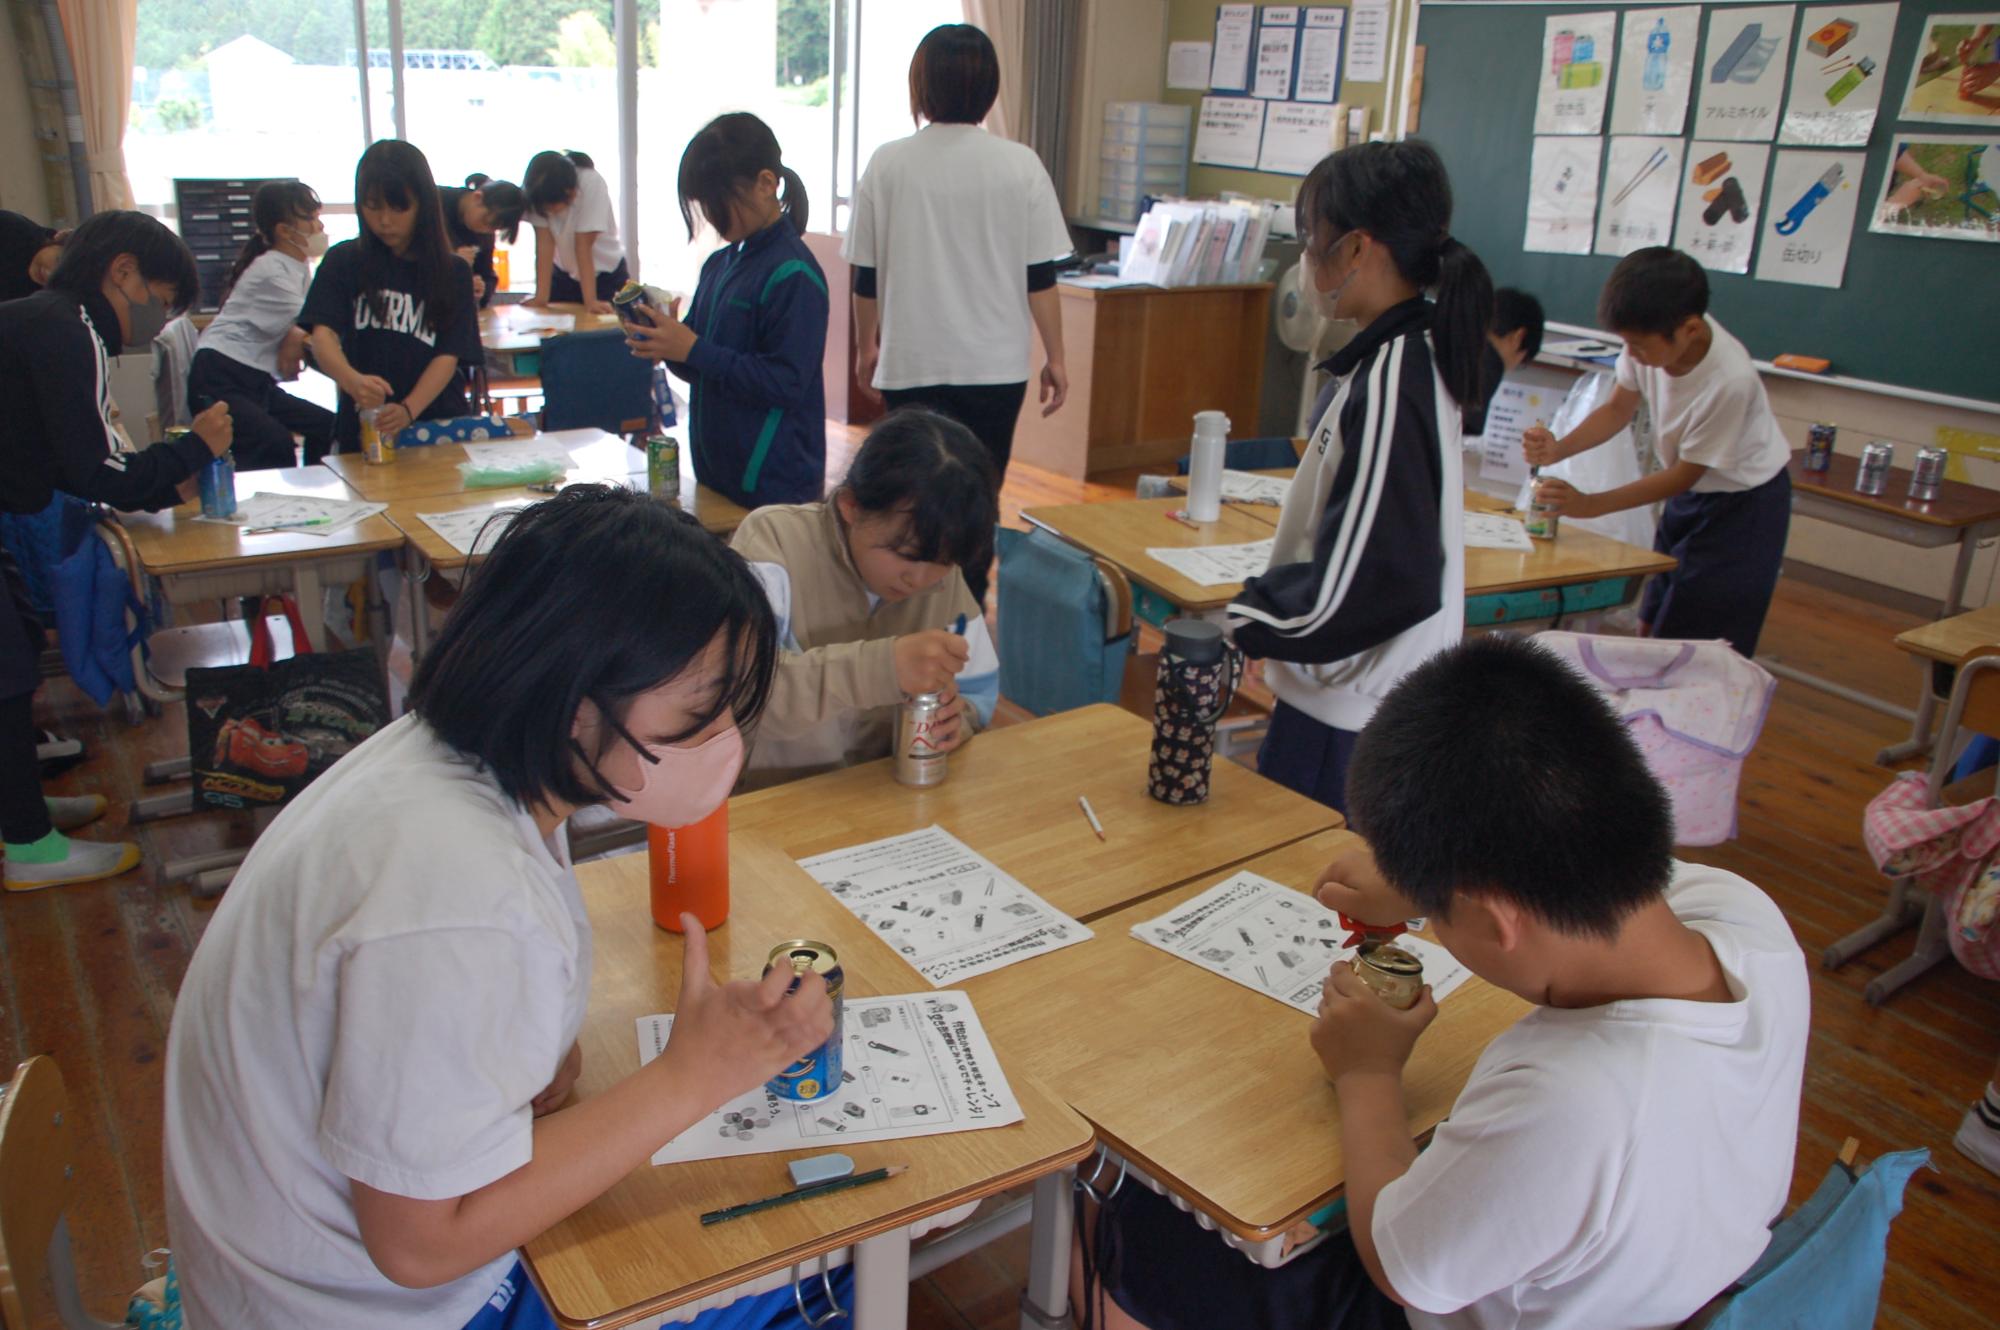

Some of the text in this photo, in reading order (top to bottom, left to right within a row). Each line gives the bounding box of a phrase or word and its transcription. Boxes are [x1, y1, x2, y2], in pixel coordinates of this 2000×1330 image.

[1705, 106, 1769, 119] アルミホイル
[1782, 247, 1821, 264] 缶切り
